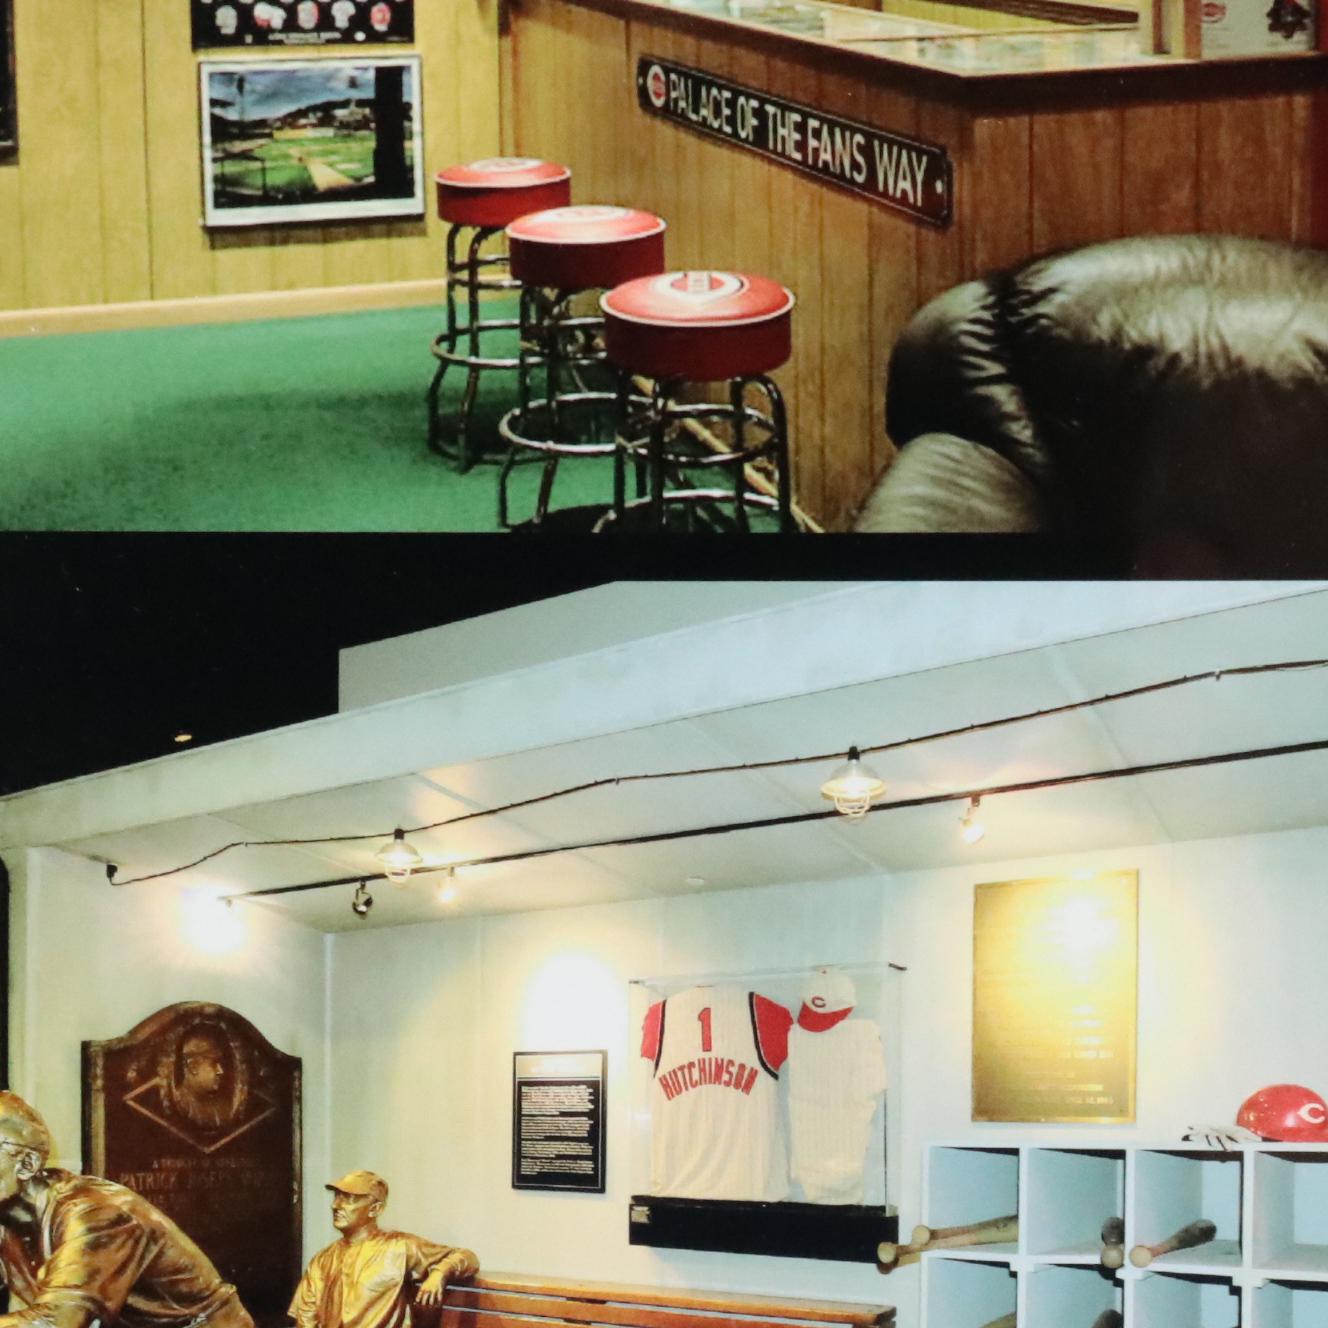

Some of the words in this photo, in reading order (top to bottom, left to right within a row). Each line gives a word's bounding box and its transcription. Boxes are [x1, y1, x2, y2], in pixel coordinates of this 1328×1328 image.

[669, 72, 732, 134] PALACE
[737, 96, 759, 141] OF
[765, 104, 802, 161] THE
[806, 117, 867, 184] FANS
[873, 140, 928, 207] WAY
[698, 1007, 712, 1052] 1
[658, 1056, 758, 1101] HUTCHINSON
